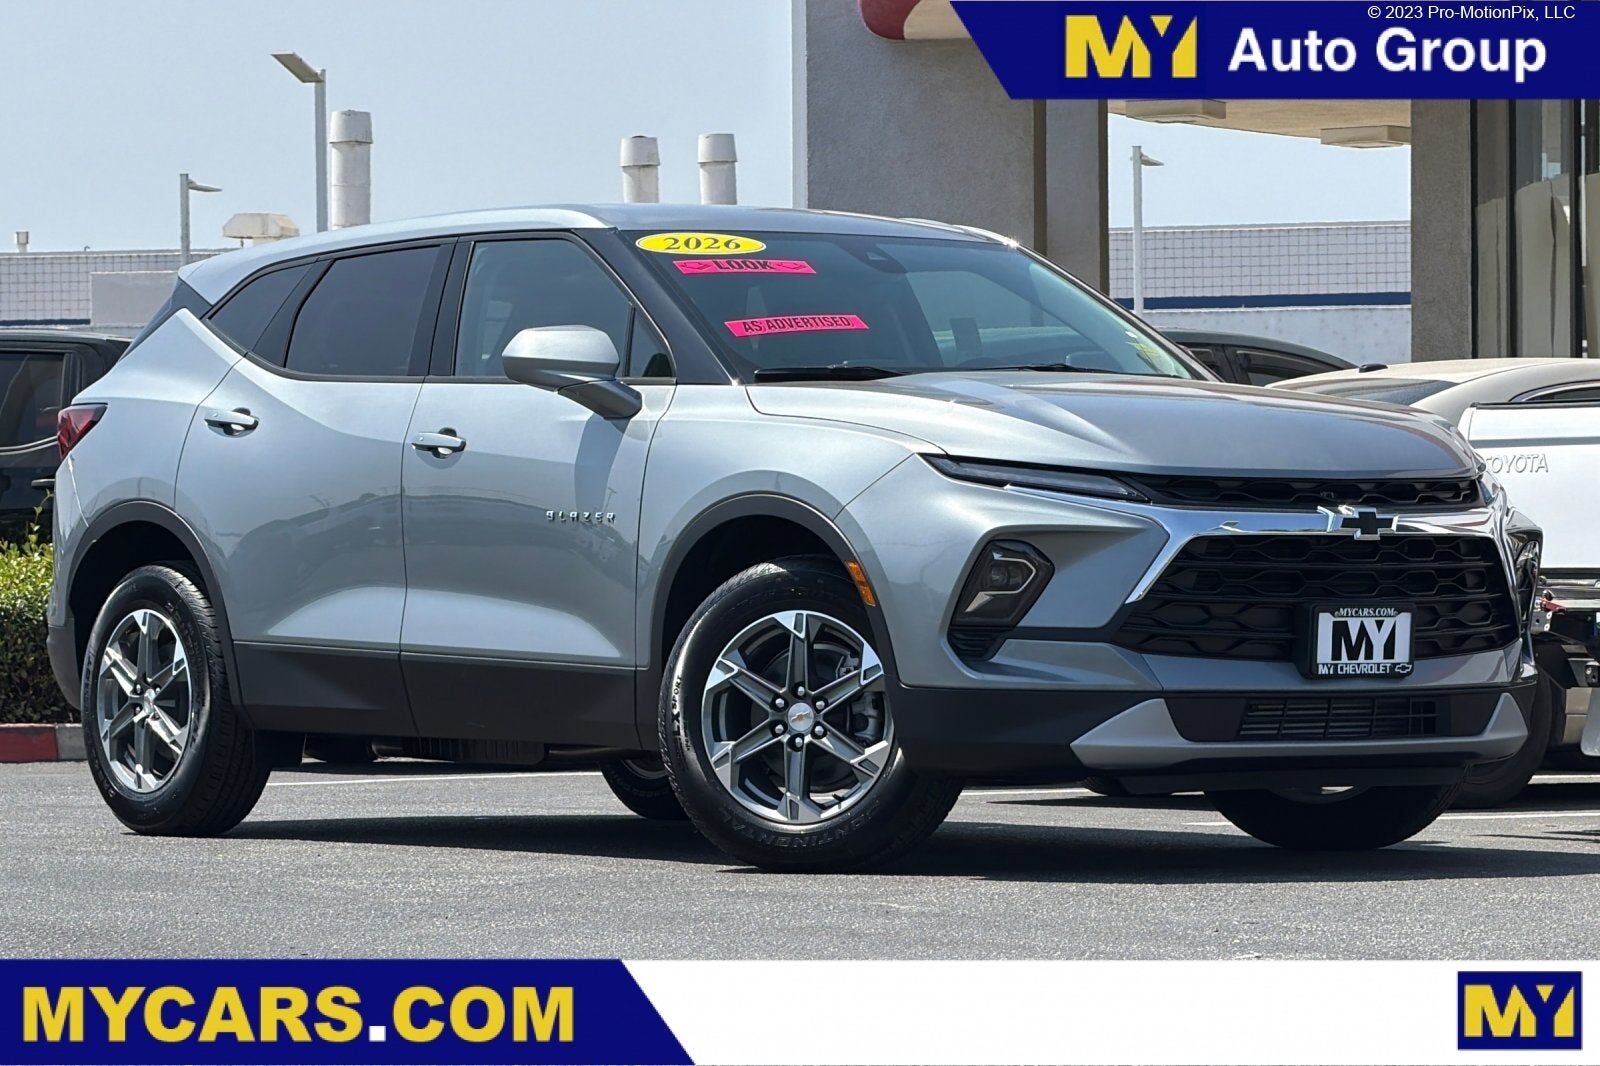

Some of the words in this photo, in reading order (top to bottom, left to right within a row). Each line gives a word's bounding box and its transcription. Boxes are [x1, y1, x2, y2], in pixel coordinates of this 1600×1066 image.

[664, 237, 741, 250] 2026
[712, 259, 776, 270] LOOK
[742, 321, 762, 332] AS
[766, 316, 851, 330] ADVERTISED
[545, 510, 616, 523] BLAZER
[1330, 619, 1396, 662] MY
[1318, 663, 1334, 675] MY
[1337, 663, 1391, 675] CHEVROLET
